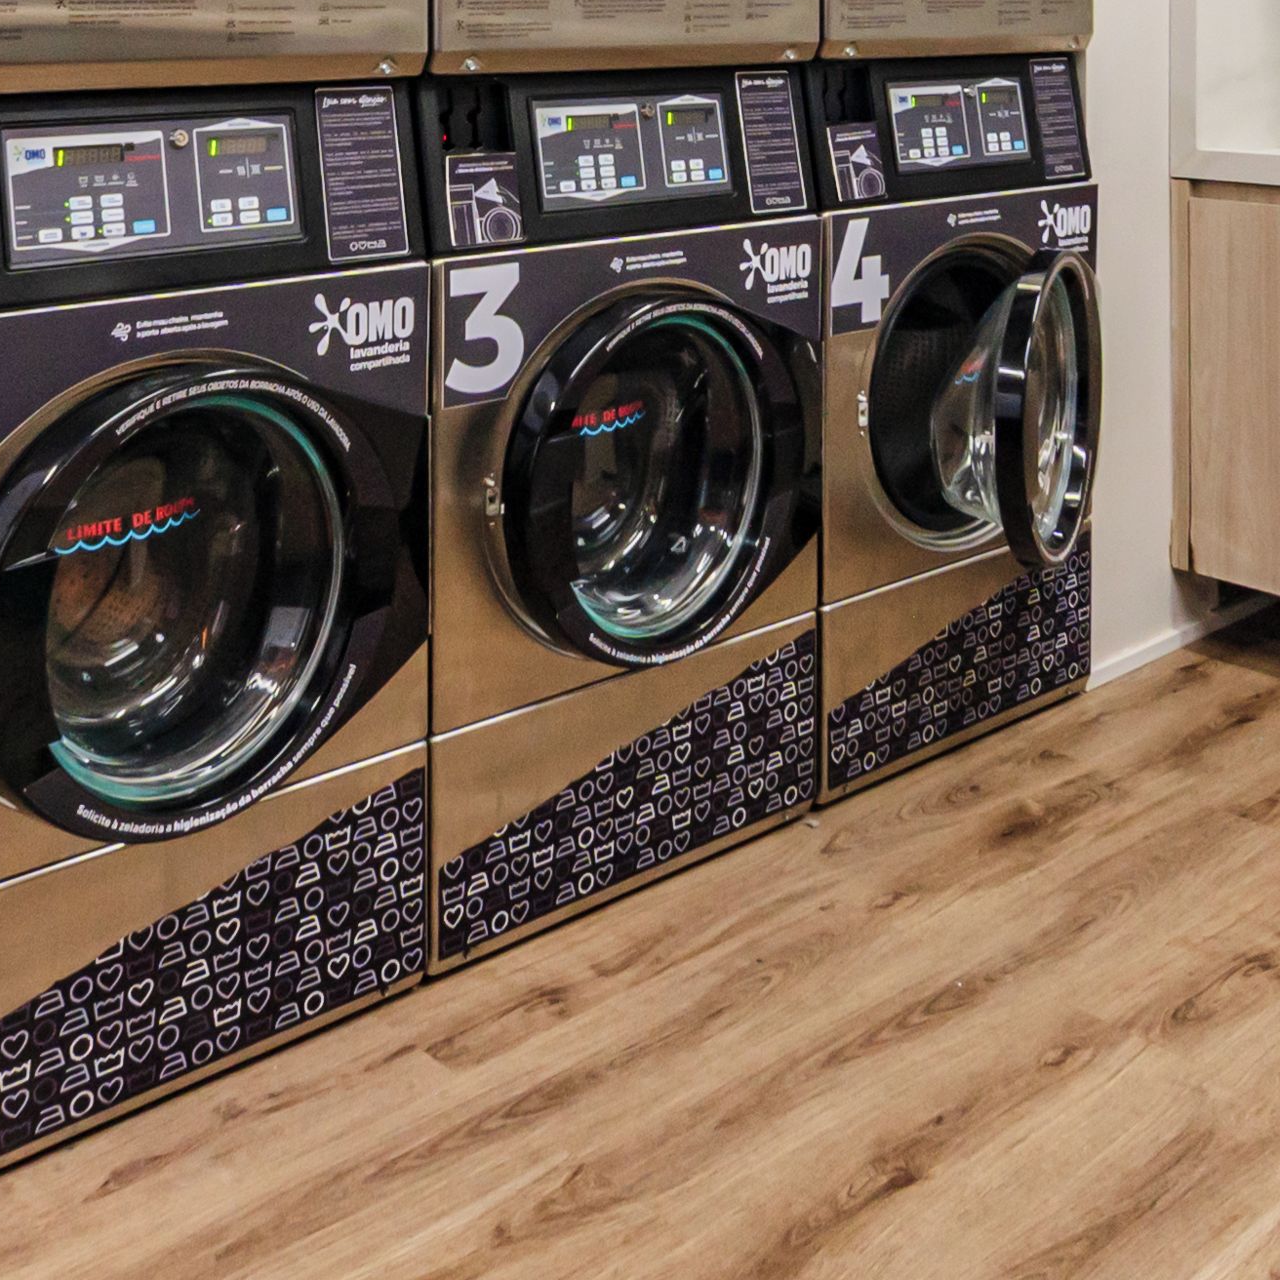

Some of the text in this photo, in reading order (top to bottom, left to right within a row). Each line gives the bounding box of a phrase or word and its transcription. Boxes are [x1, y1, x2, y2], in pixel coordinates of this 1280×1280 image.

[25, 149, 45, 161] OMO
[1057, 205, 1091, 237] OMO
[765, 244, 811, 282] OMO
[831, 218, 889, 323] 4
[347, 297, 414, 345] OMO
[445, 262, 524, 393] 3
[350, 340, 410, 359] lavanderia
[350, 353, 410, 372] compartilhada
[66, 517, 122, 540] LIMITE
[132, 509, 152, 528] DE
